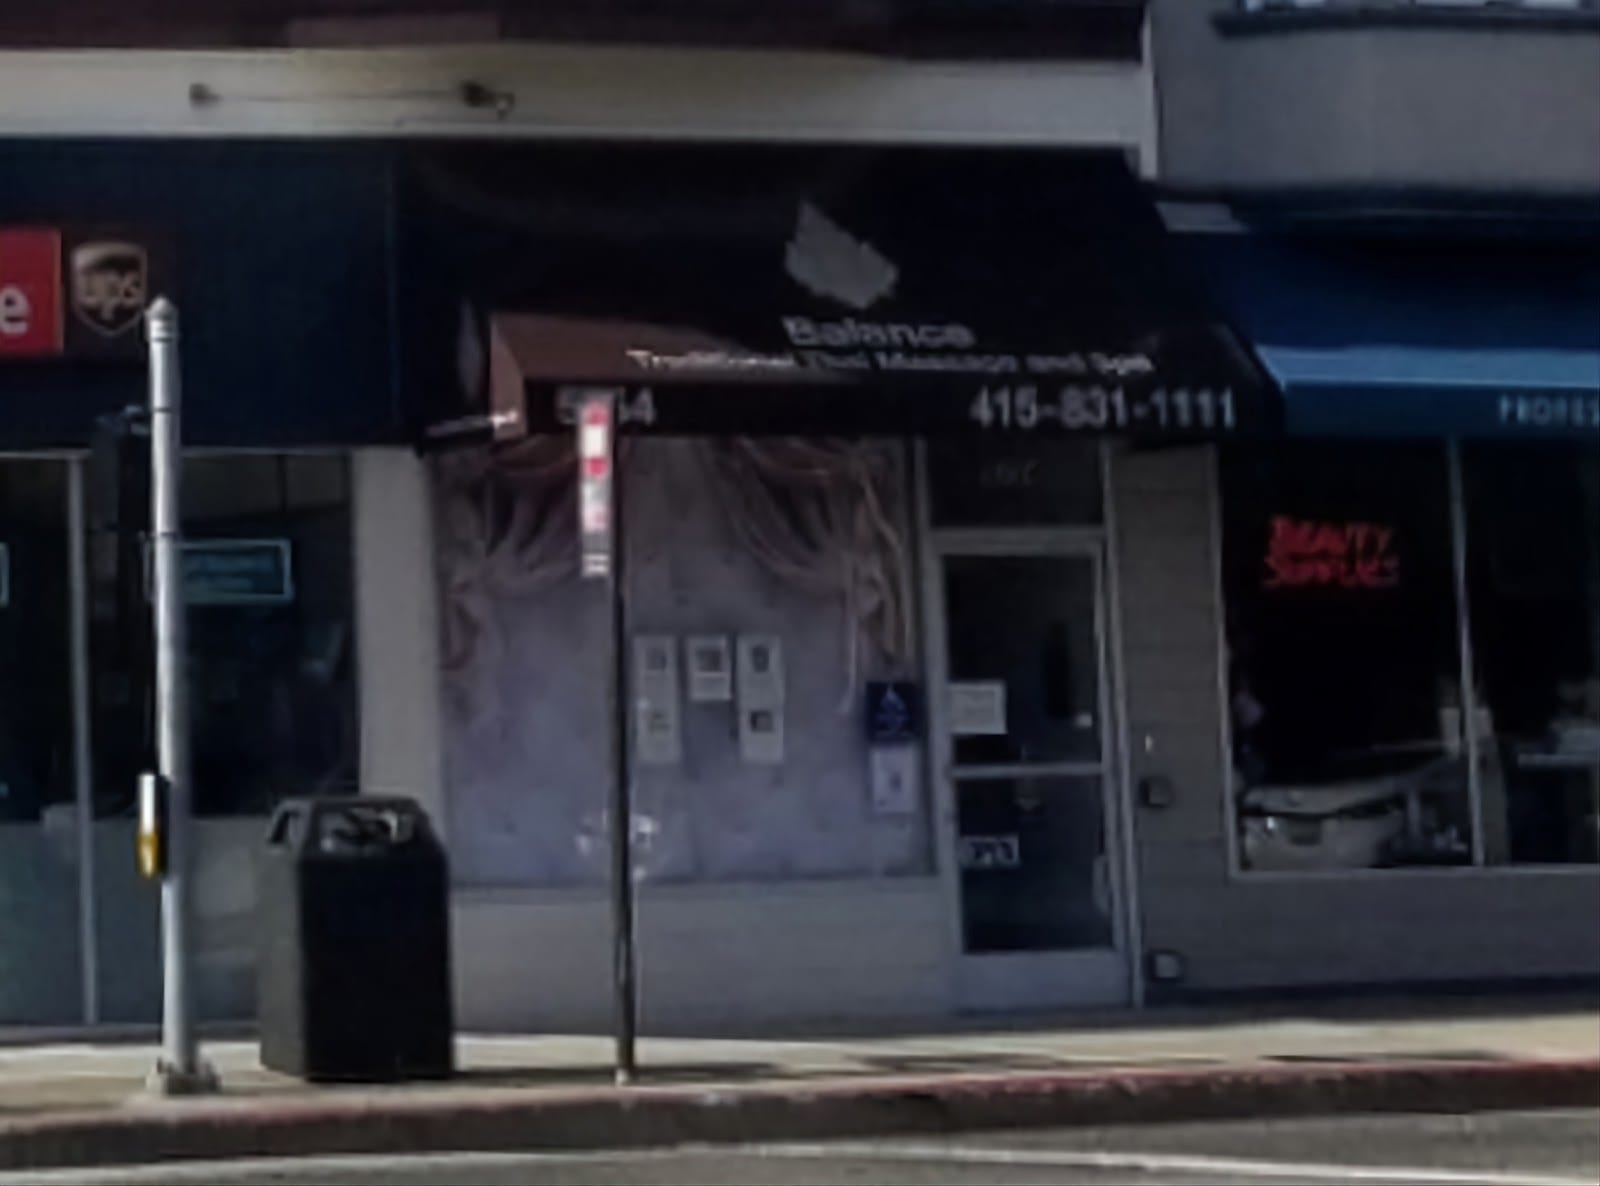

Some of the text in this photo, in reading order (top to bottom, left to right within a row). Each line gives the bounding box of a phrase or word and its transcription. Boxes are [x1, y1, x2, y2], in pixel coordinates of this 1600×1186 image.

[781, 316, 976, 347] Balance
[875, 351, 1018, 373] Massage
[1025, 353, 1087, 372] and
[1089, 352, 1154, 376] Spa
[968, 385, 1238, 430] 415-831-1111
[1269, 515, 1394, 555] BEAUTY
